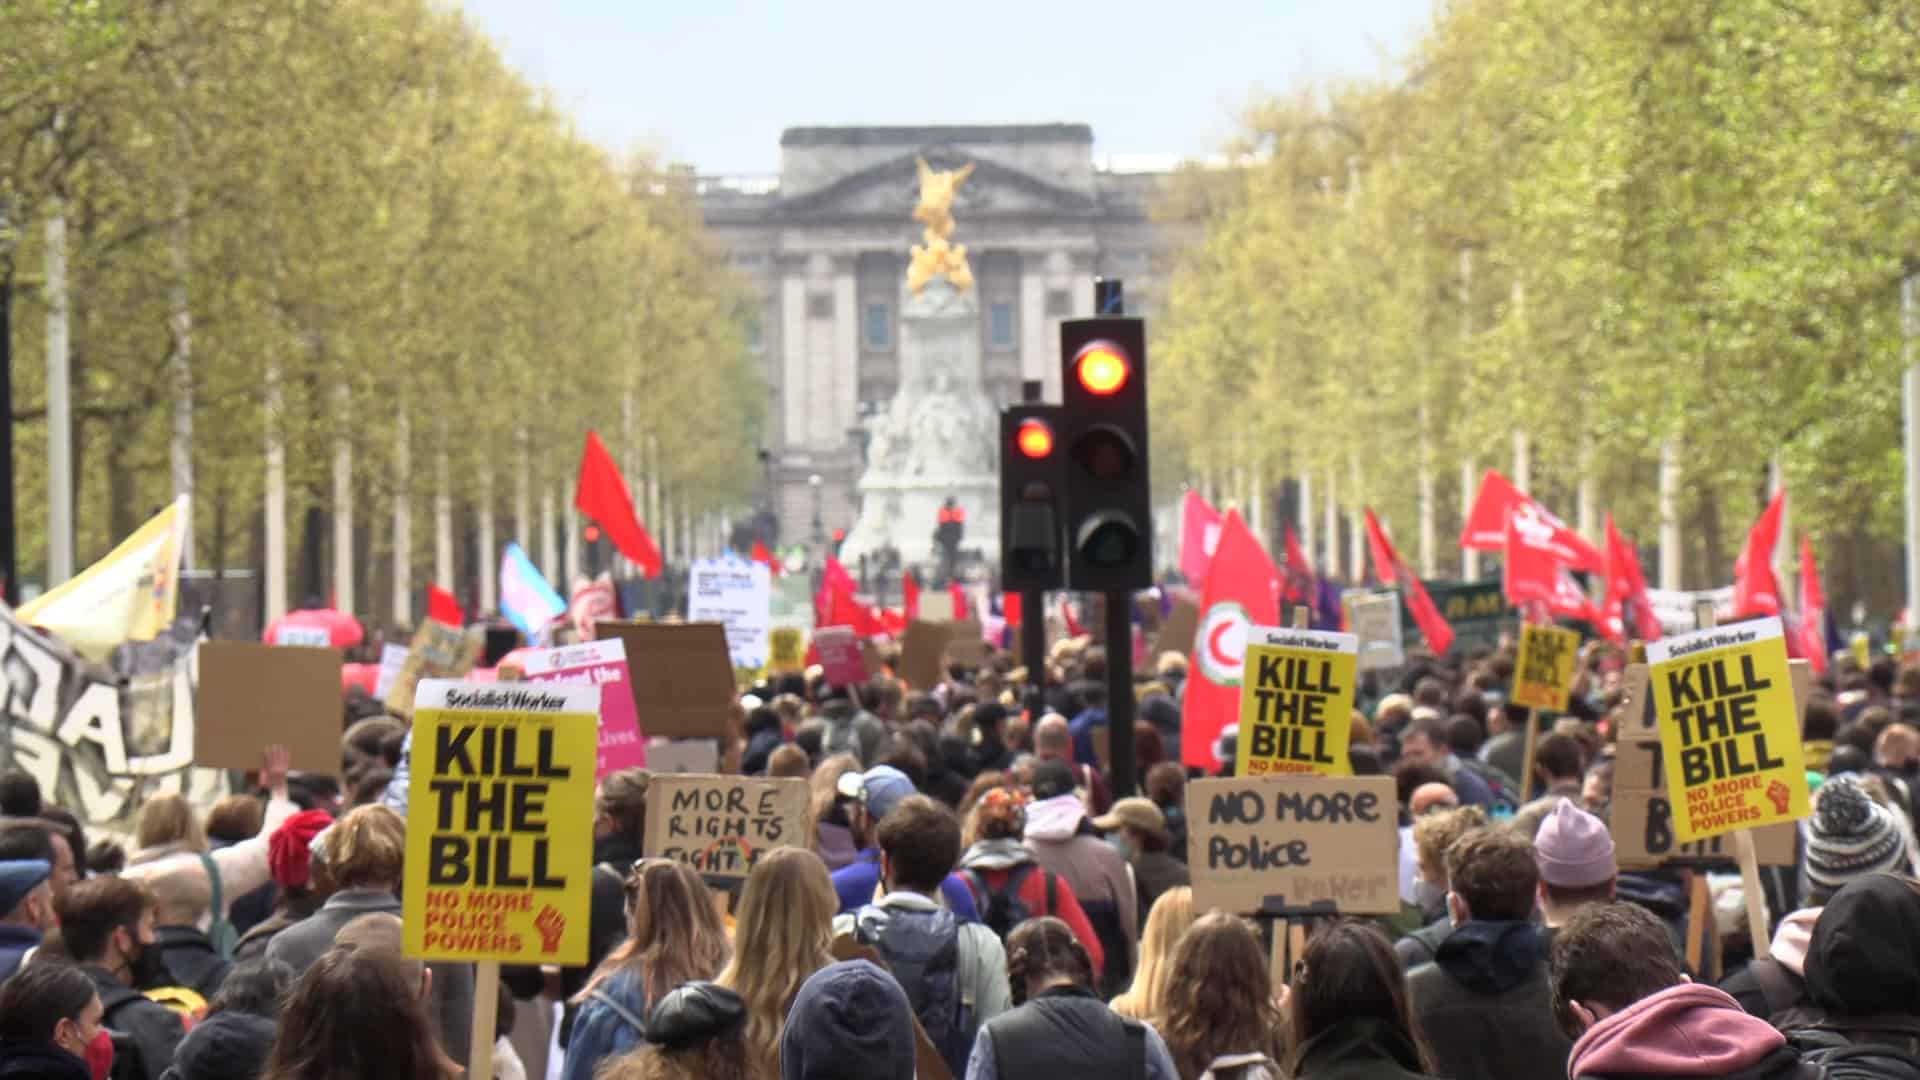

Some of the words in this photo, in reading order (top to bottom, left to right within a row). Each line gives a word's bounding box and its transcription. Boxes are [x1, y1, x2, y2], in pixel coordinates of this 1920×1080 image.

[1304, 638, 1339, 650] Worker
[1669, 636, 1713, 658] Socialist
[1713, 631, 1756, 645] Worker
[1258, 655, 1340, 694] KILL
[1668, 654, 1771, 708] KILL
[511, 690, 567, 711] Worker
[1254, 689, 1326, 727] THE
[1671, 694, 1761, 746] THE
[434, 725, 570, 778] KILL
[1251, 724, 1334, 763] BILL
[1249, 759, 1268, 771] NO
[1680, 734, 1785, 787] BILL
[672, 786, 781, 815] MORE
[1685, 788, 1708, 803] NO
[1713, 776, 1763, 796] MORE
[429, 781, 548, 833] THE
[1209, 790, 1265, 824] NO
[1688, 794, 1745, 817] POLICE
[1690, 806, 1761, 832] POWERS
[669, 815, 784, 841] RIGHTS
[428, 835, 567, 889] BILL
[1209, 834, 1310, 870] Police
[425, 890, 459, 908] NO
[466, 892, 534, 912] MORE
[424, 911, 505, 929] POLICE
[423, 932, 523, 952] POWERS
